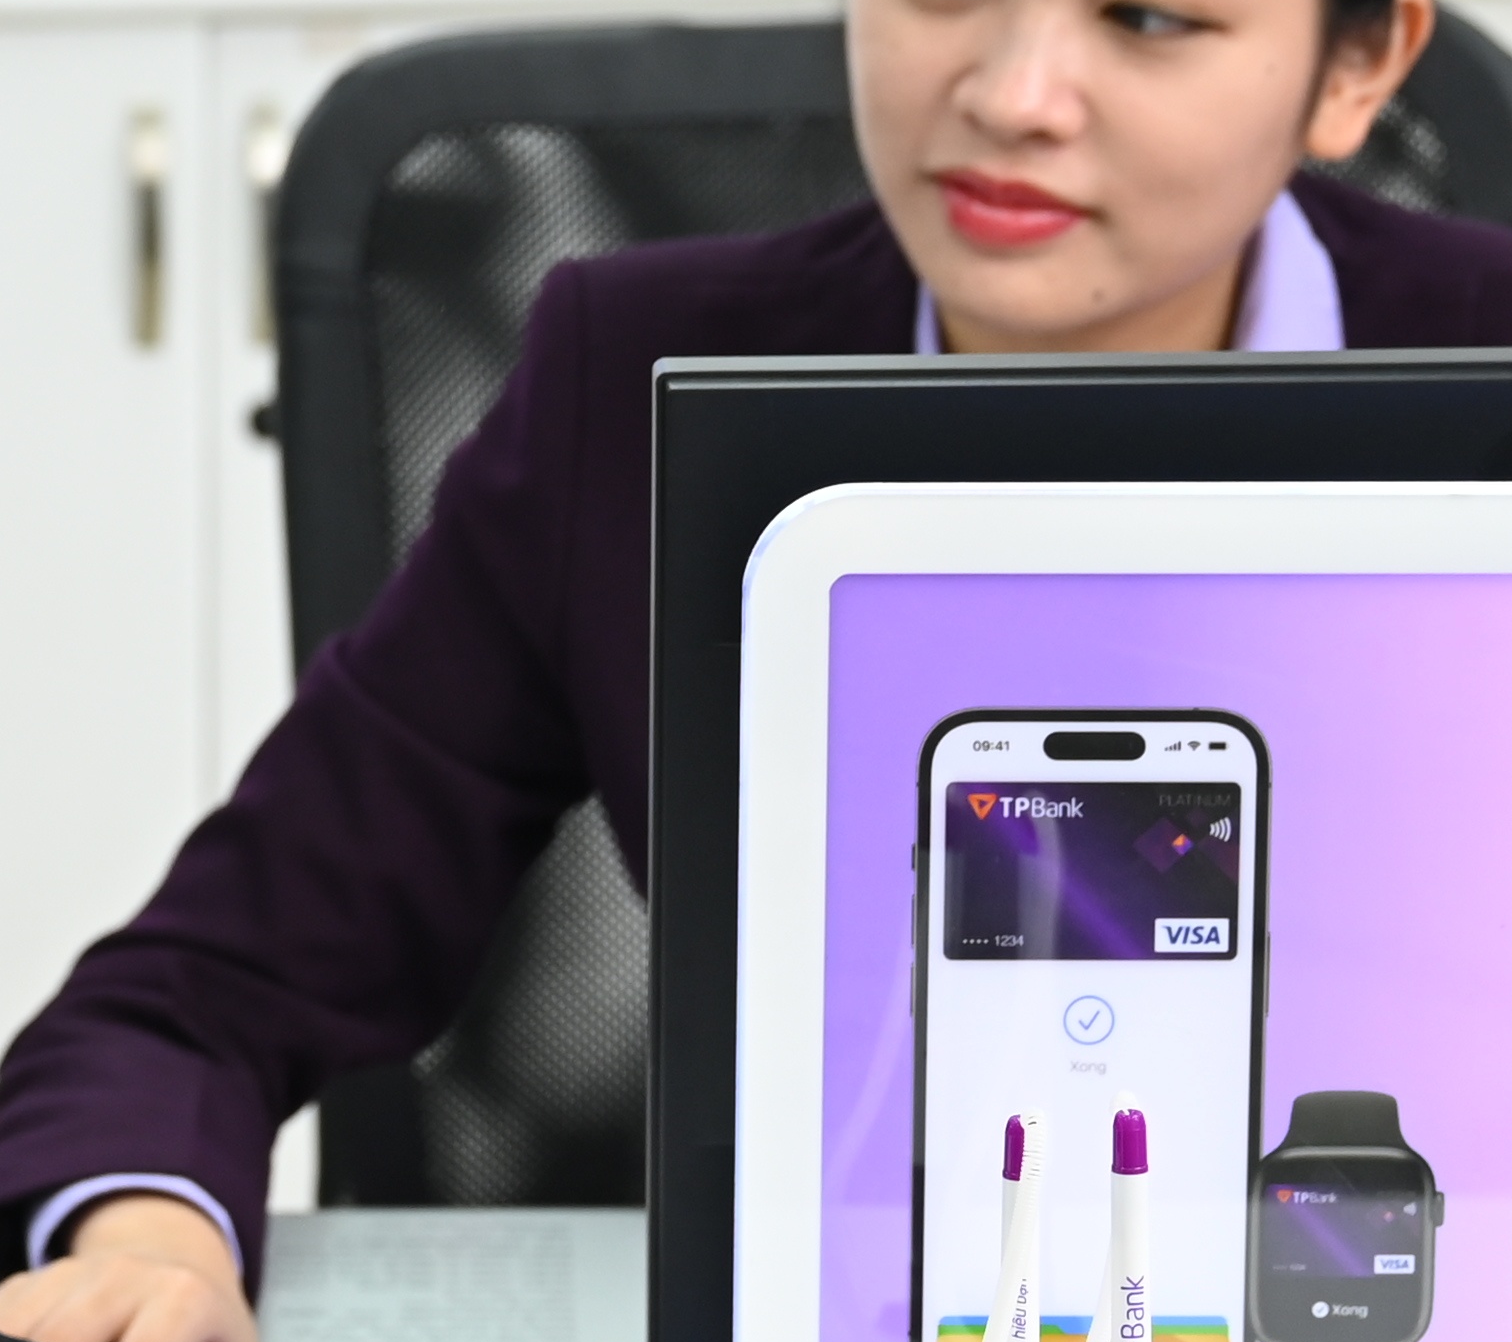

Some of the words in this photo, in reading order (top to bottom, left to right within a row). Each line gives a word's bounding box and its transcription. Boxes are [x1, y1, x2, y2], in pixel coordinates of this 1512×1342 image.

[972, 741, 1010, 752] 09:41
[999, 797, 1085, 819] TPBank
[1159, 794, 1230, 808] PLATINUM
[994, 935, 1025, 946] 1234
[1162, 925, 1221, 945] VISA
